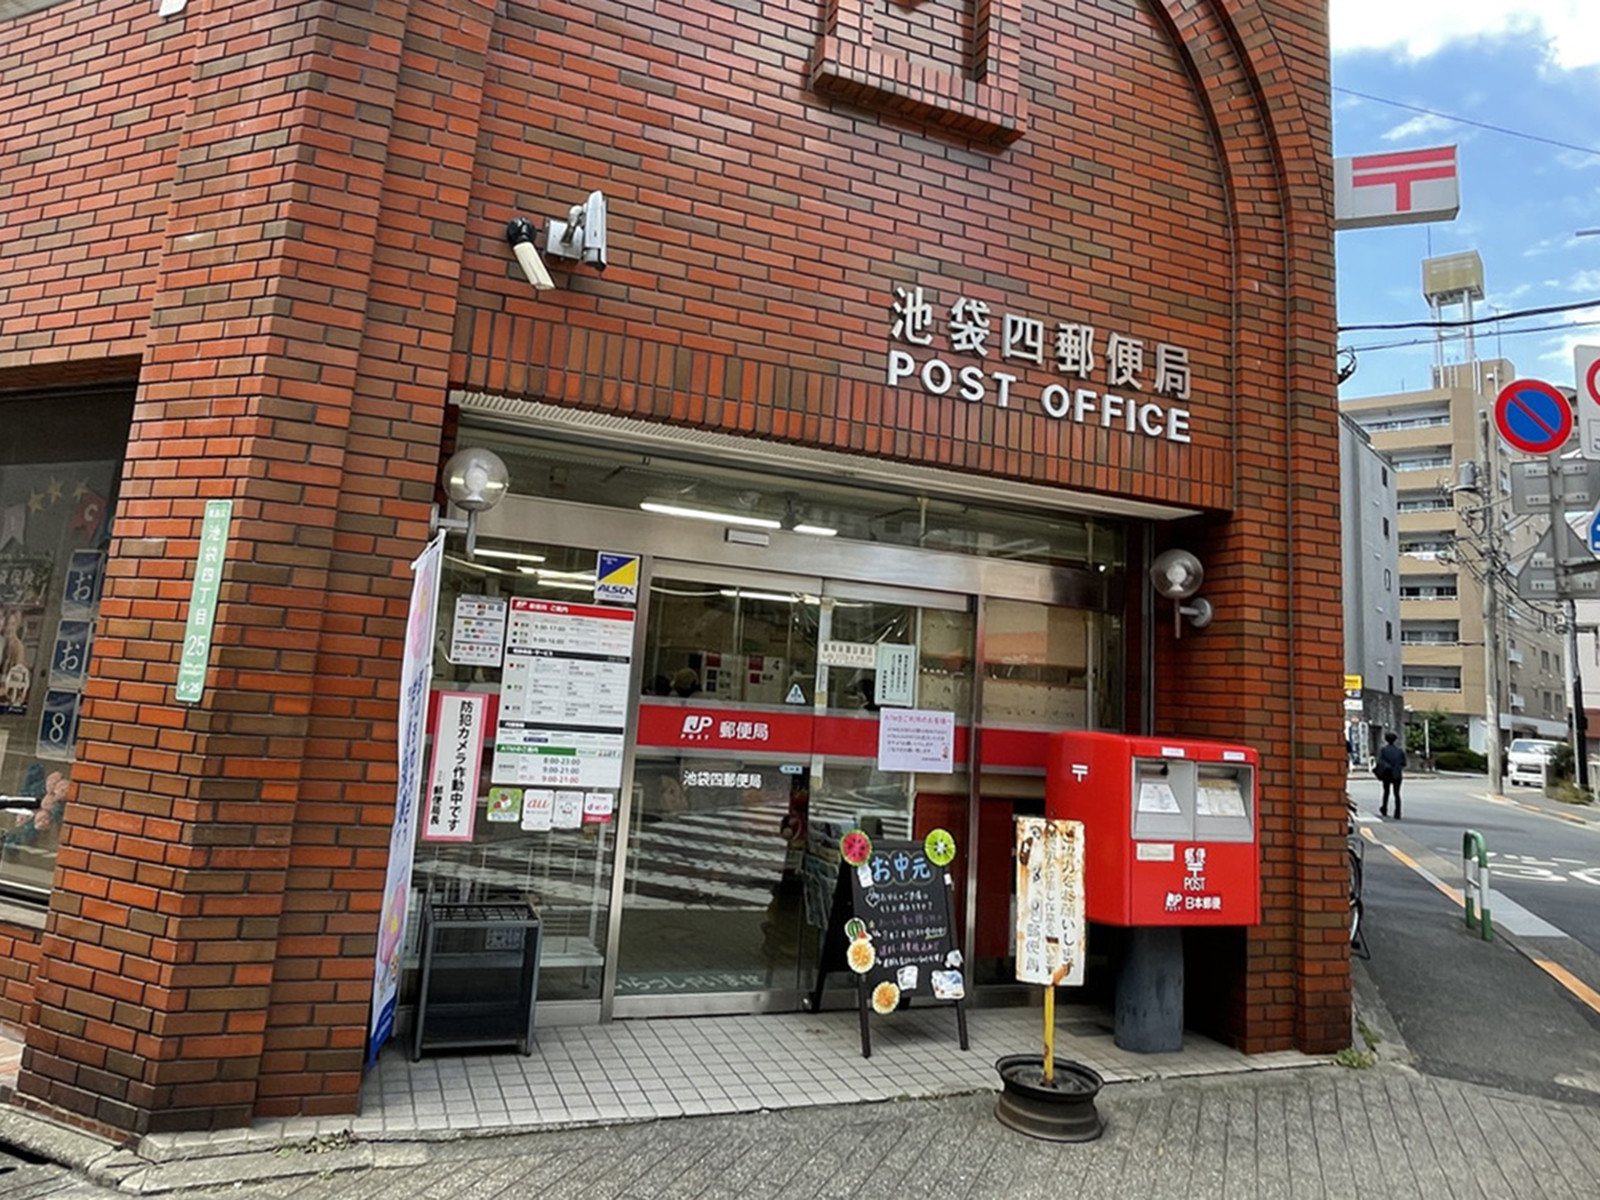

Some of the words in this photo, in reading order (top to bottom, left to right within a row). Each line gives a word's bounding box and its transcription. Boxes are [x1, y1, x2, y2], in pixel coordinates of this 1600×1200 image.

[891, 286, 1191, 400] 池袋四郵便局
[887, 350, 1018, 408] POST
[1041, 384, 1191, 443] OFFICE
[598, 584, 635, 595] ALSOK
[186, 635, 206, 656] 25
[719, 720, 769, 741] 郵便局
[448, 700, 474, 832] 防犯カメラ作動中です
[682, 770, 762, 789] 池袋四郵便局
[430, 785, 444, 826] 郵便局長
[527, 799, 550, 809] au
[872, 853, 931, 882] お中元
[1184, 877, 1206, 891] POST
[1185, 896, 1221, 910] 日本郵便
